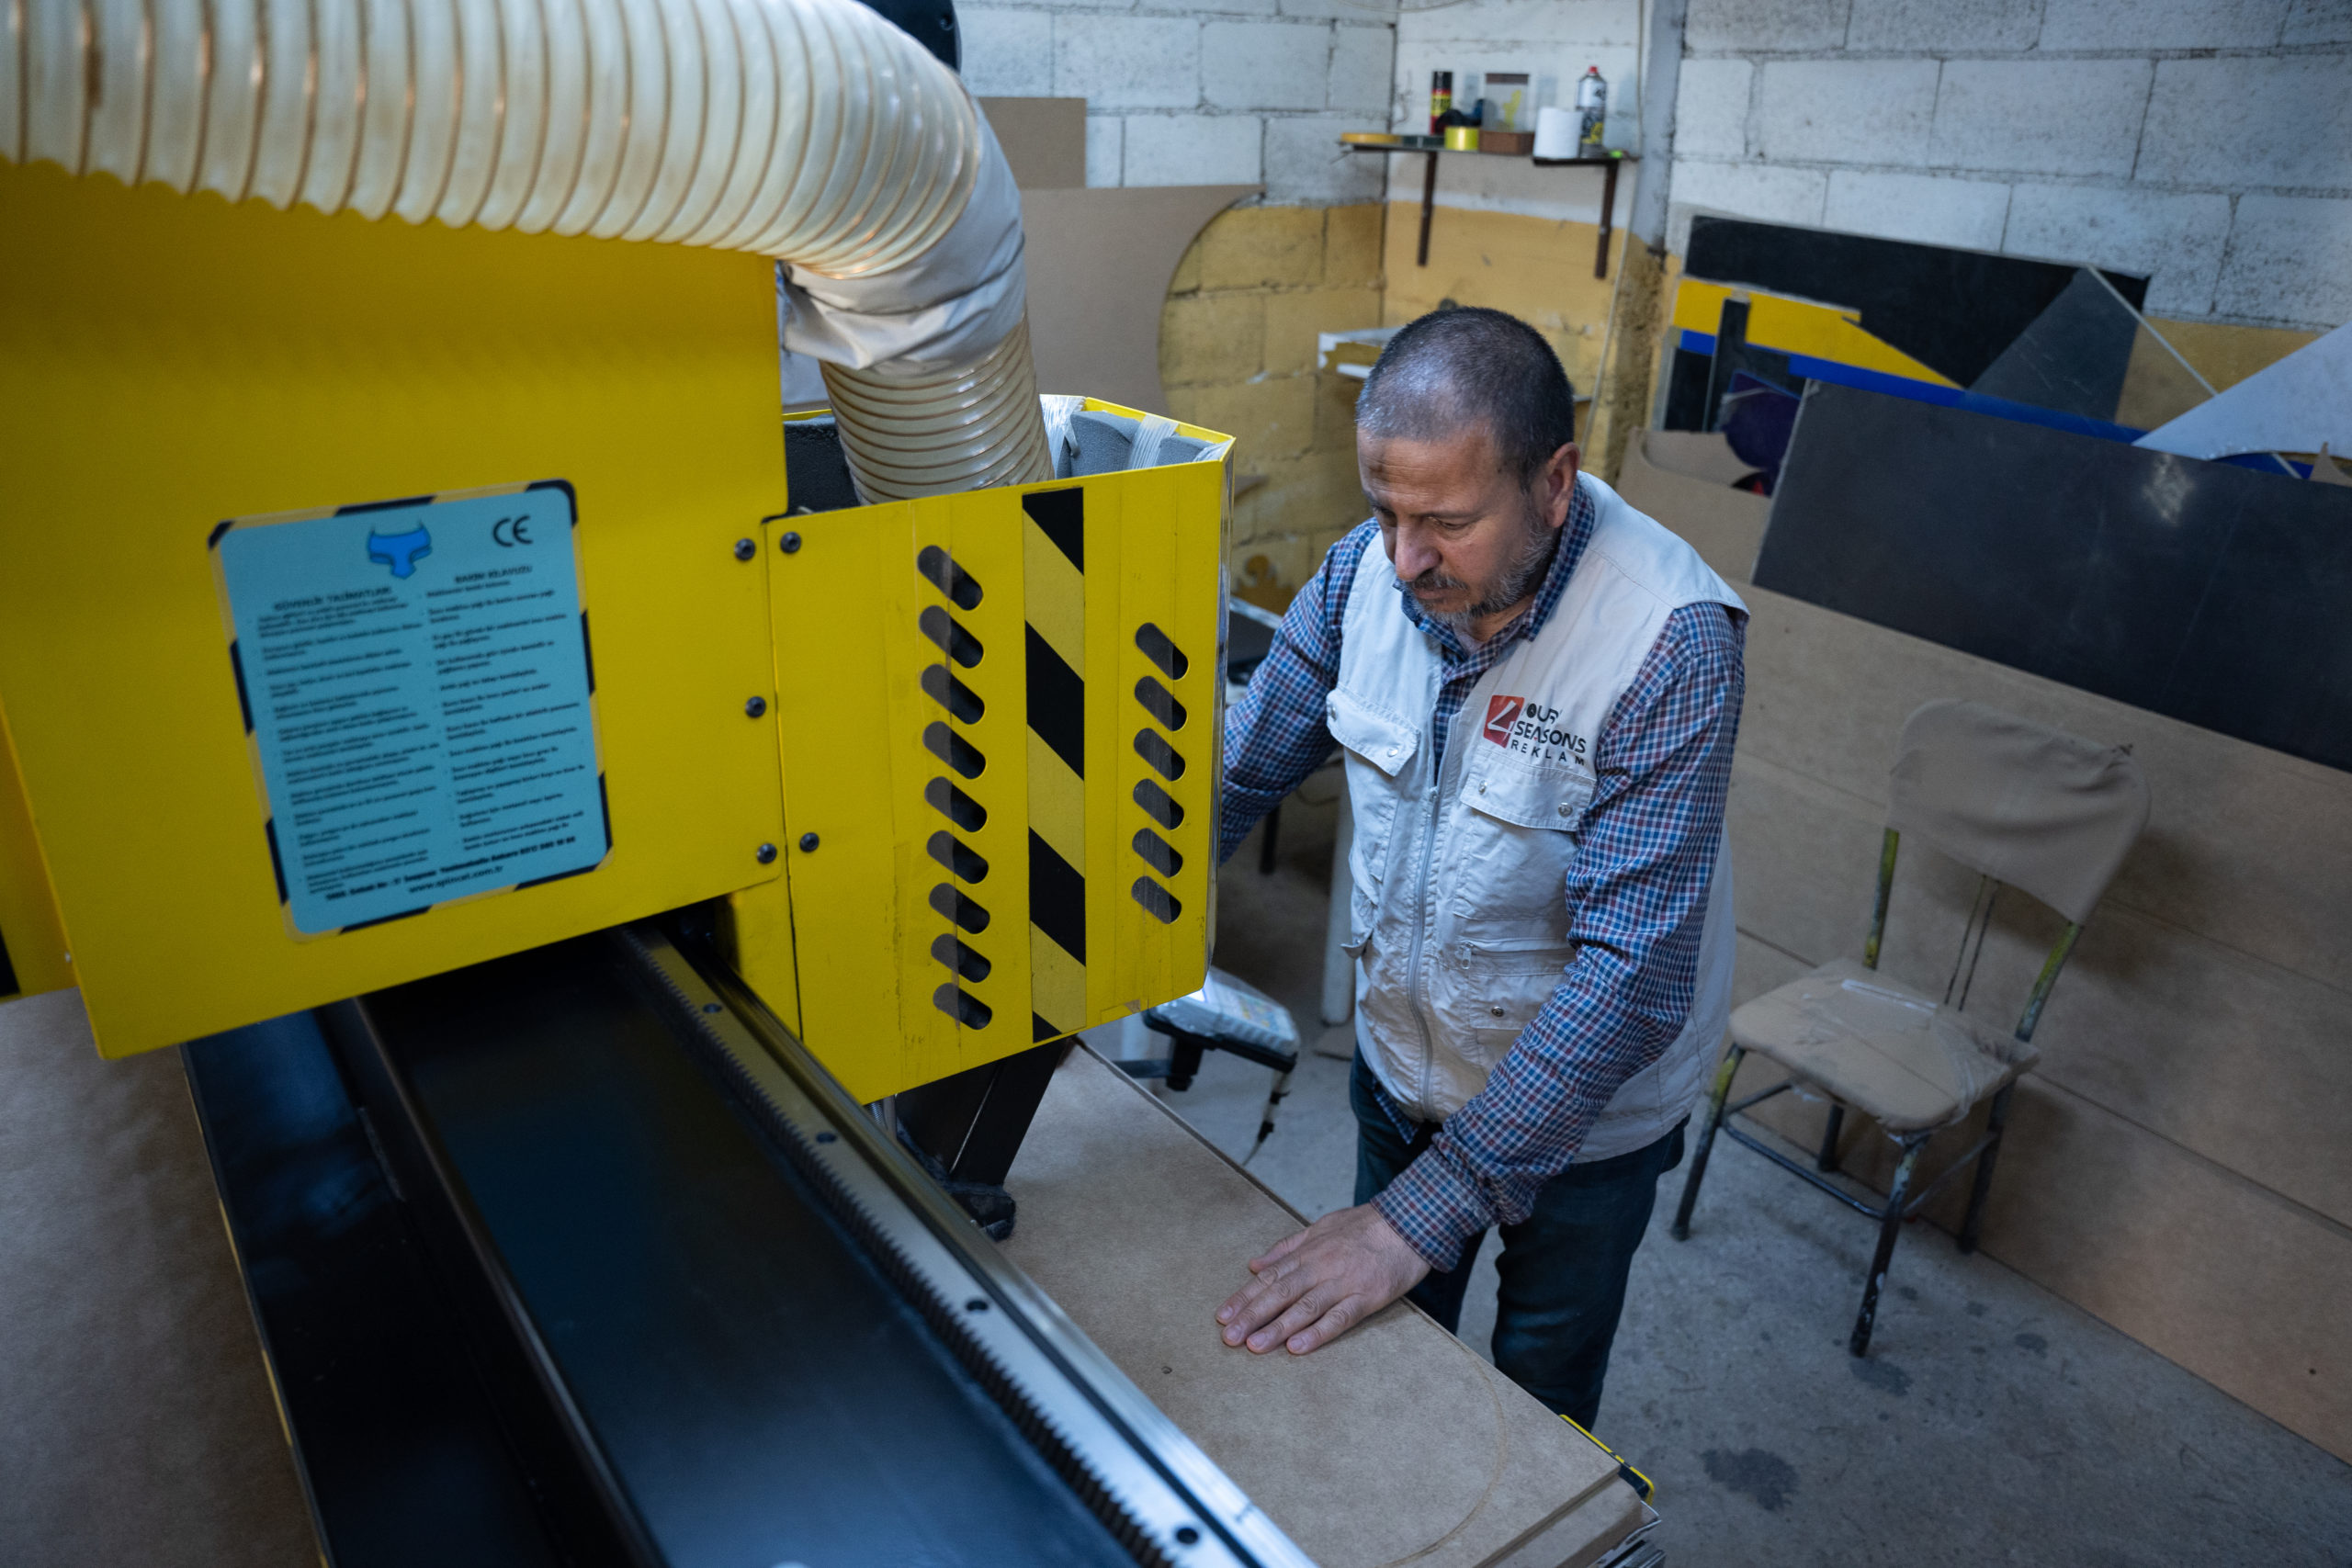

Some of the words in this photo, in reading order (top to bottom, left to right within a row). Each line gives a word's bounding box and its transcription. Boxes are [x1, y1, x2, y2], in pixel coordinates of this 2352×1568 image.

[492, 515, 533, 547] CE
[1510, 739, 1585, 766] REKLAM
[1514, 720, 1587, 753] SEASONS
